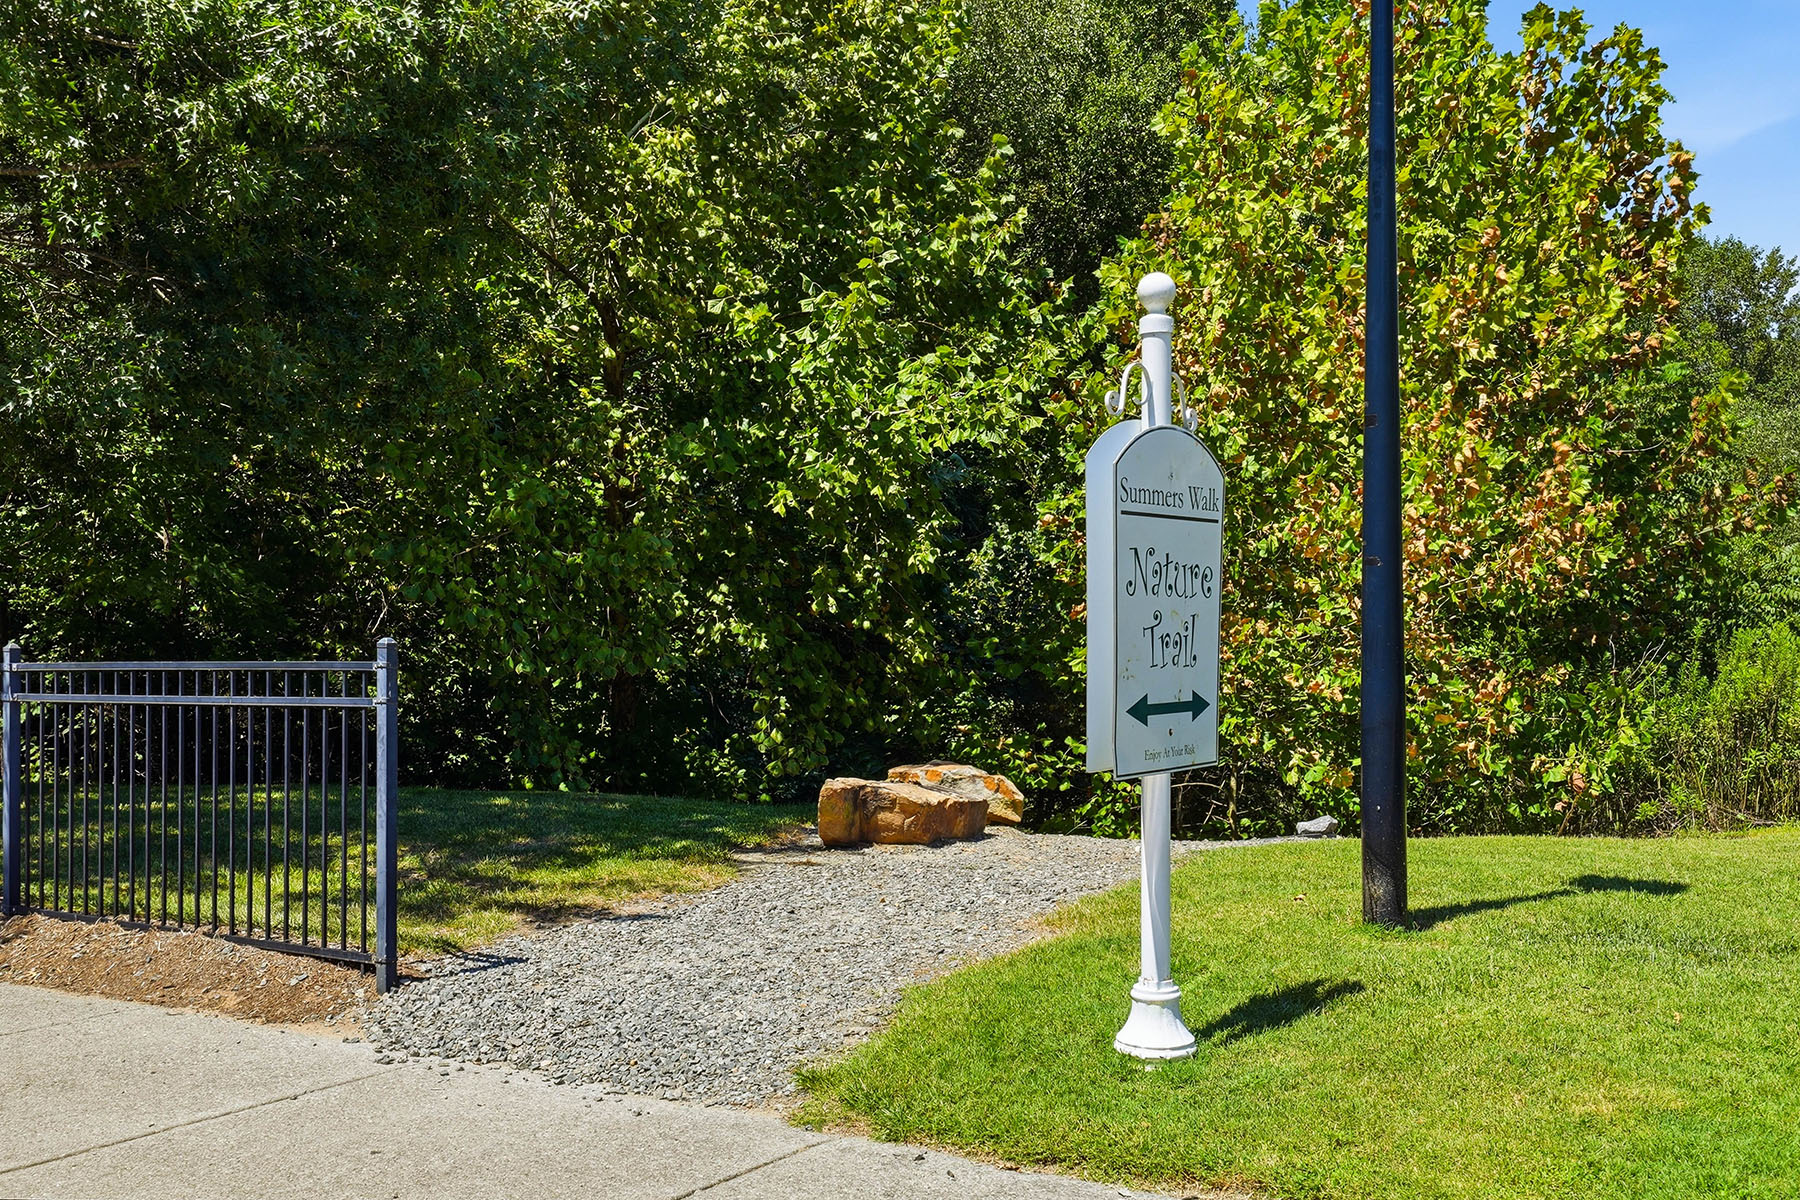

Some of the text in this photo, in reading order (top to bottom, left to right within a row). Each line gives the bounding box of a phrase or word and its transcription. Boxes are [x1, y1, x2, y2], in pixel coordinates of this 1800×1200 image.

[1120, 476, 1220, 512] Summers Walk
[1126, 547, 1213, 599] Nature
[1143, 610, 1197, 669] Trail
[1144, 744, 1196, 763] Enjoy At Your Risk
